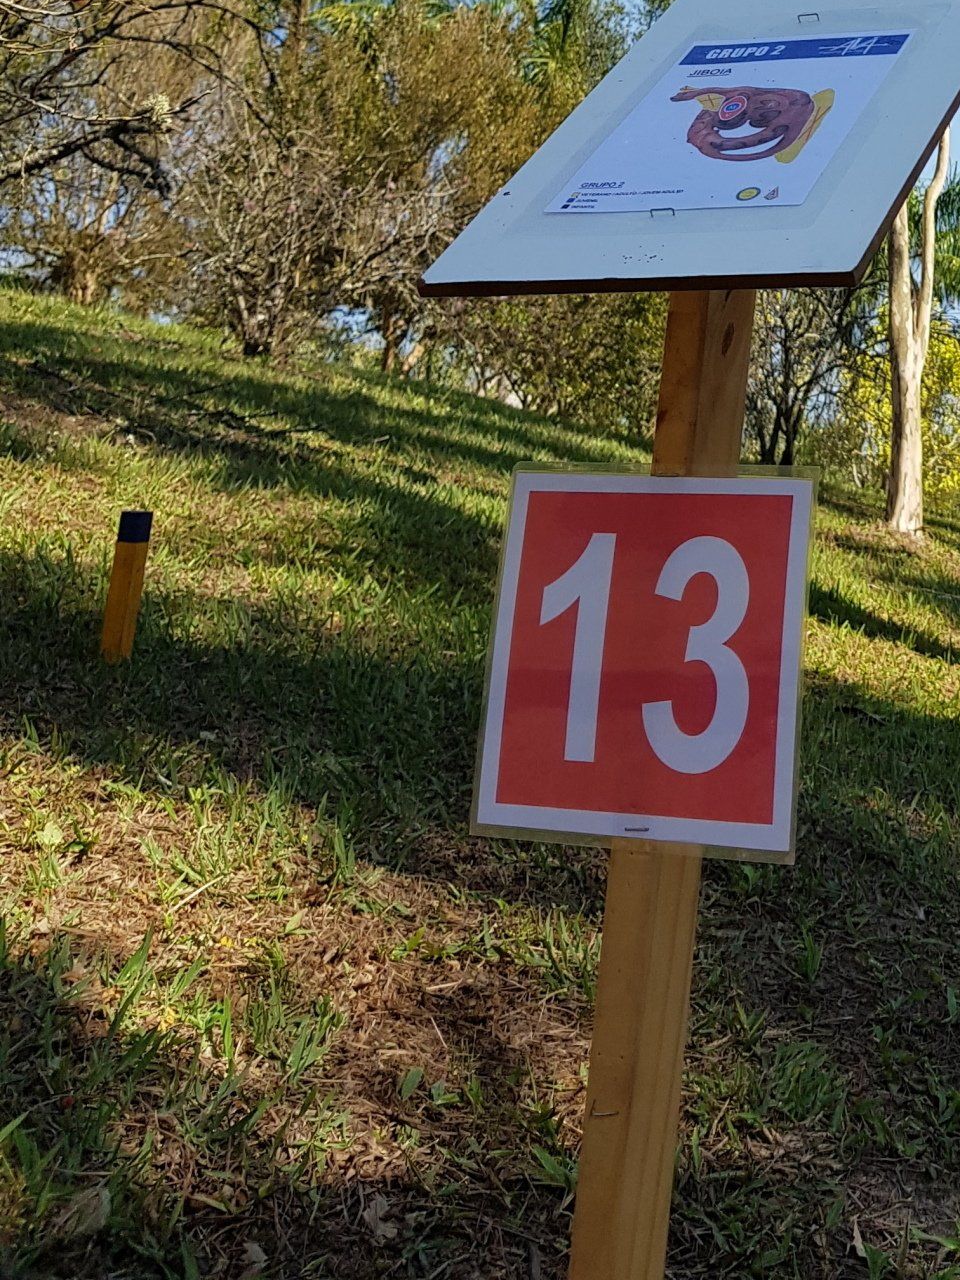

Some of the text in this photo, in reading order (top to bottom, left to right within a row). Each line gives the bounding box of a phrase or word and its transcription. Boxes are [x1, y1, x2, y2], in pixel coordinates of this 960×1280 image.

[705, 44, 786, 59] GRUPO 2
[689, 68, 732, 76] JIBOIA
[539, 532, 750, 774] 13
